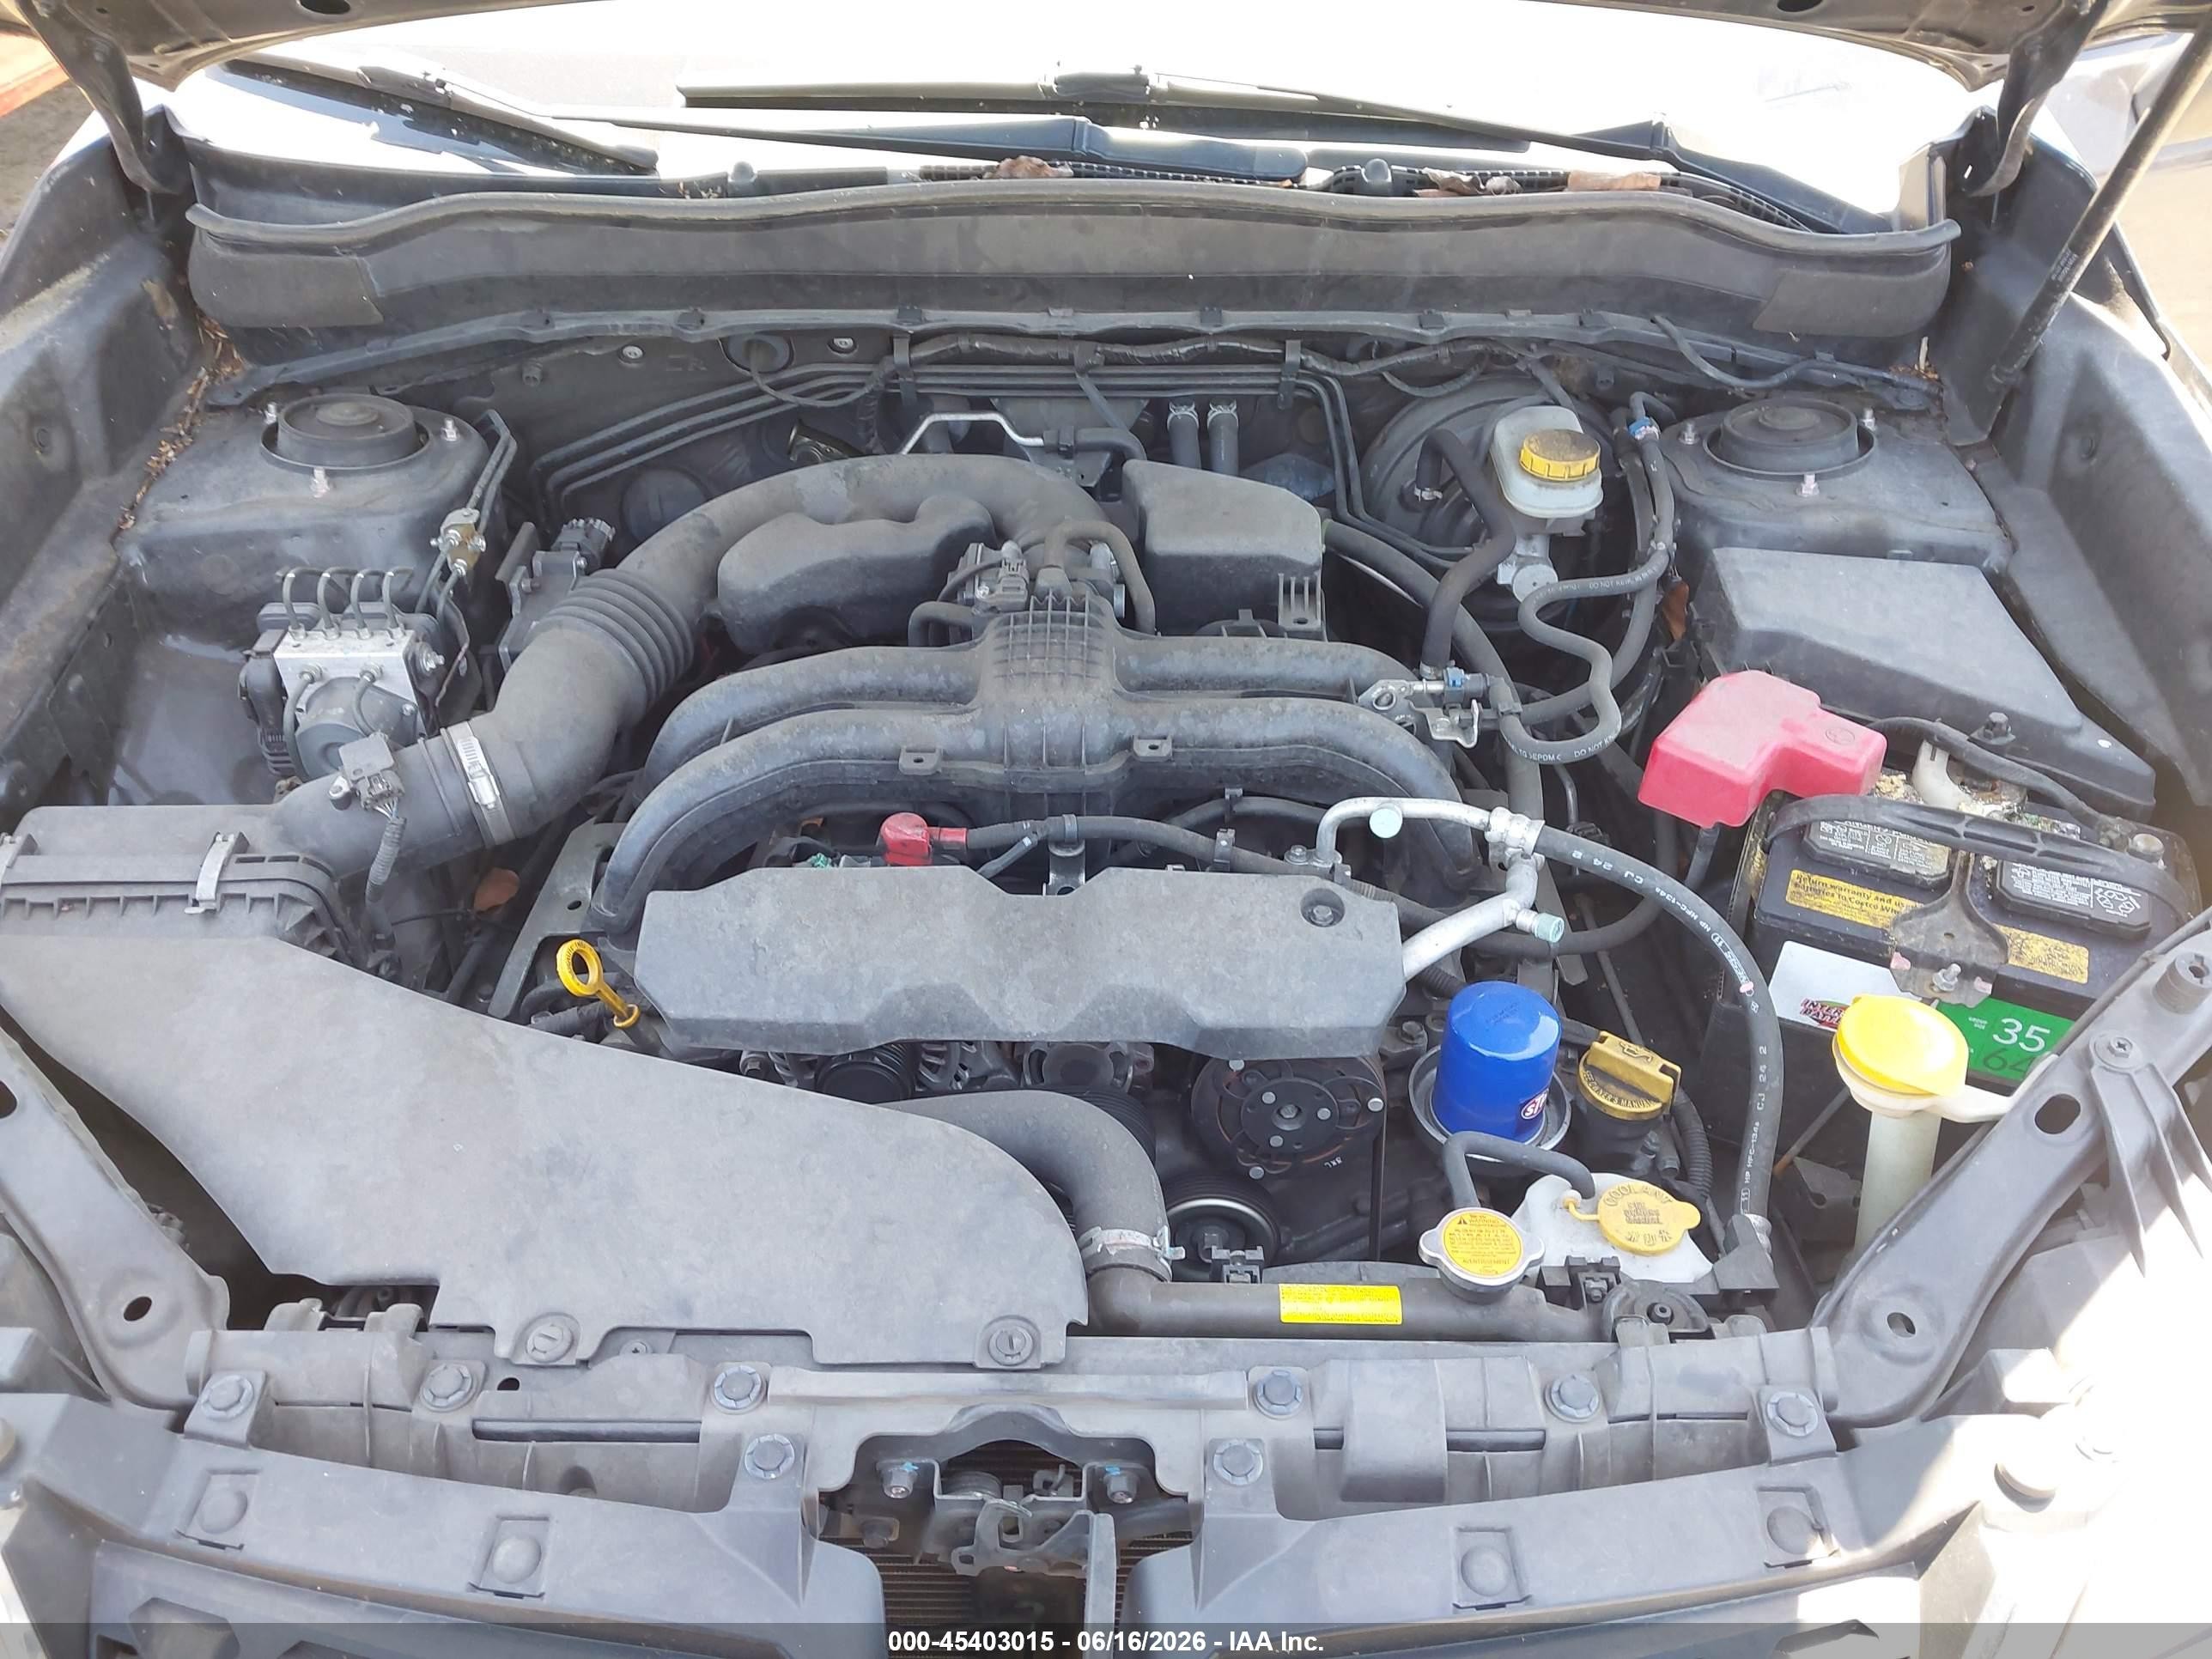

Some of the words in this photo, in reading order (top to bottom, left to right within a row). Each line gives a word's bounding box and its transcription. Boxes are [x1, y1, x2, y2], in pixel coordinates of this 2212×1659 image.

[1829, 882, 1872, 901] warranty
[1874, 895, 1893, 904] and
[1849, 896, 1879, 910] Costco
[1991, 1018, 2051, 1053] 35
[1759, 1045, 1768, 1055] 2
[1756, 1092, 1765, 1111] CJ
[1602, 1183, 1674, 1207] COOLANT
